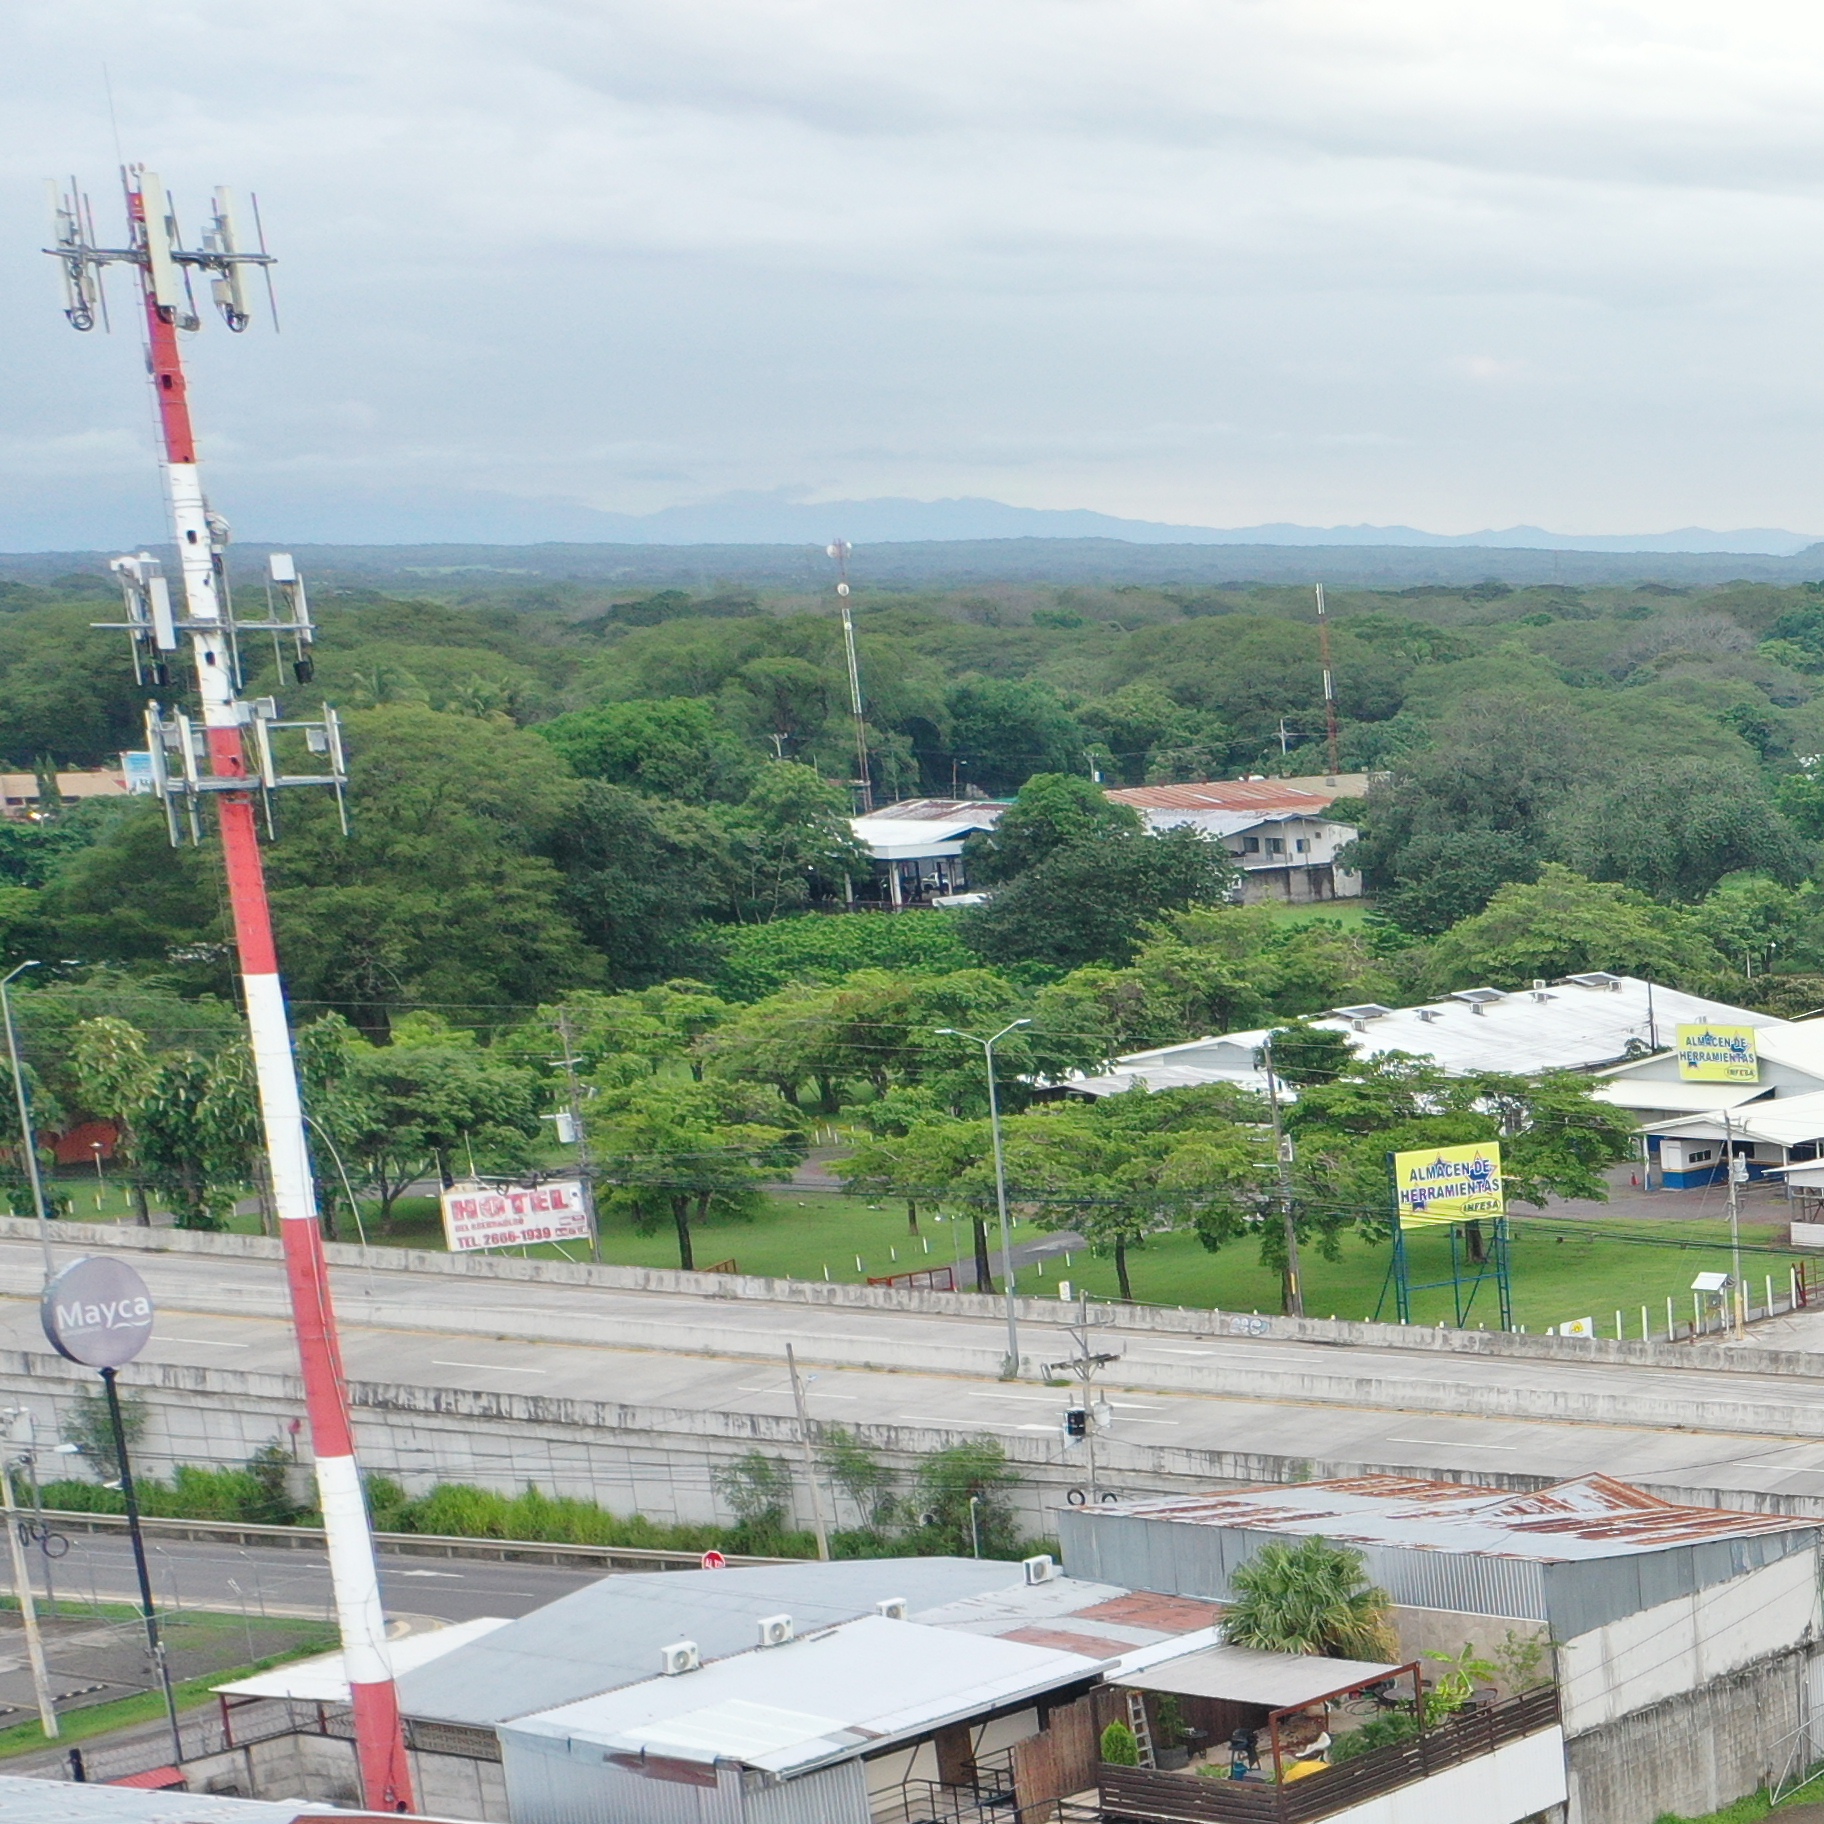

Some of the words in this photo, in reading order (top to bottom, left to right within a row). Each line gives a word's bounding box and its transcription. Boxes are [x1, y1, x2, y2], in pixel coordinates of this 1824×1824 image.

[1686, 1037, 1730, 1047] ALMACEN
[1734, 1038, 1747, 1048] DE
[1680, 1051, 1755, 1063] HERRAMIENTAS
[1409, 1162, 1469, 1182] ALMACEN
[1474, 1159, 1490, 1174] DE
[1400, 1179, 1500, 1204] HERRAMIENTAS
[451, 1189, 570, 1221] HOTEL
[56, 1297, 150, 1330] Mayca
